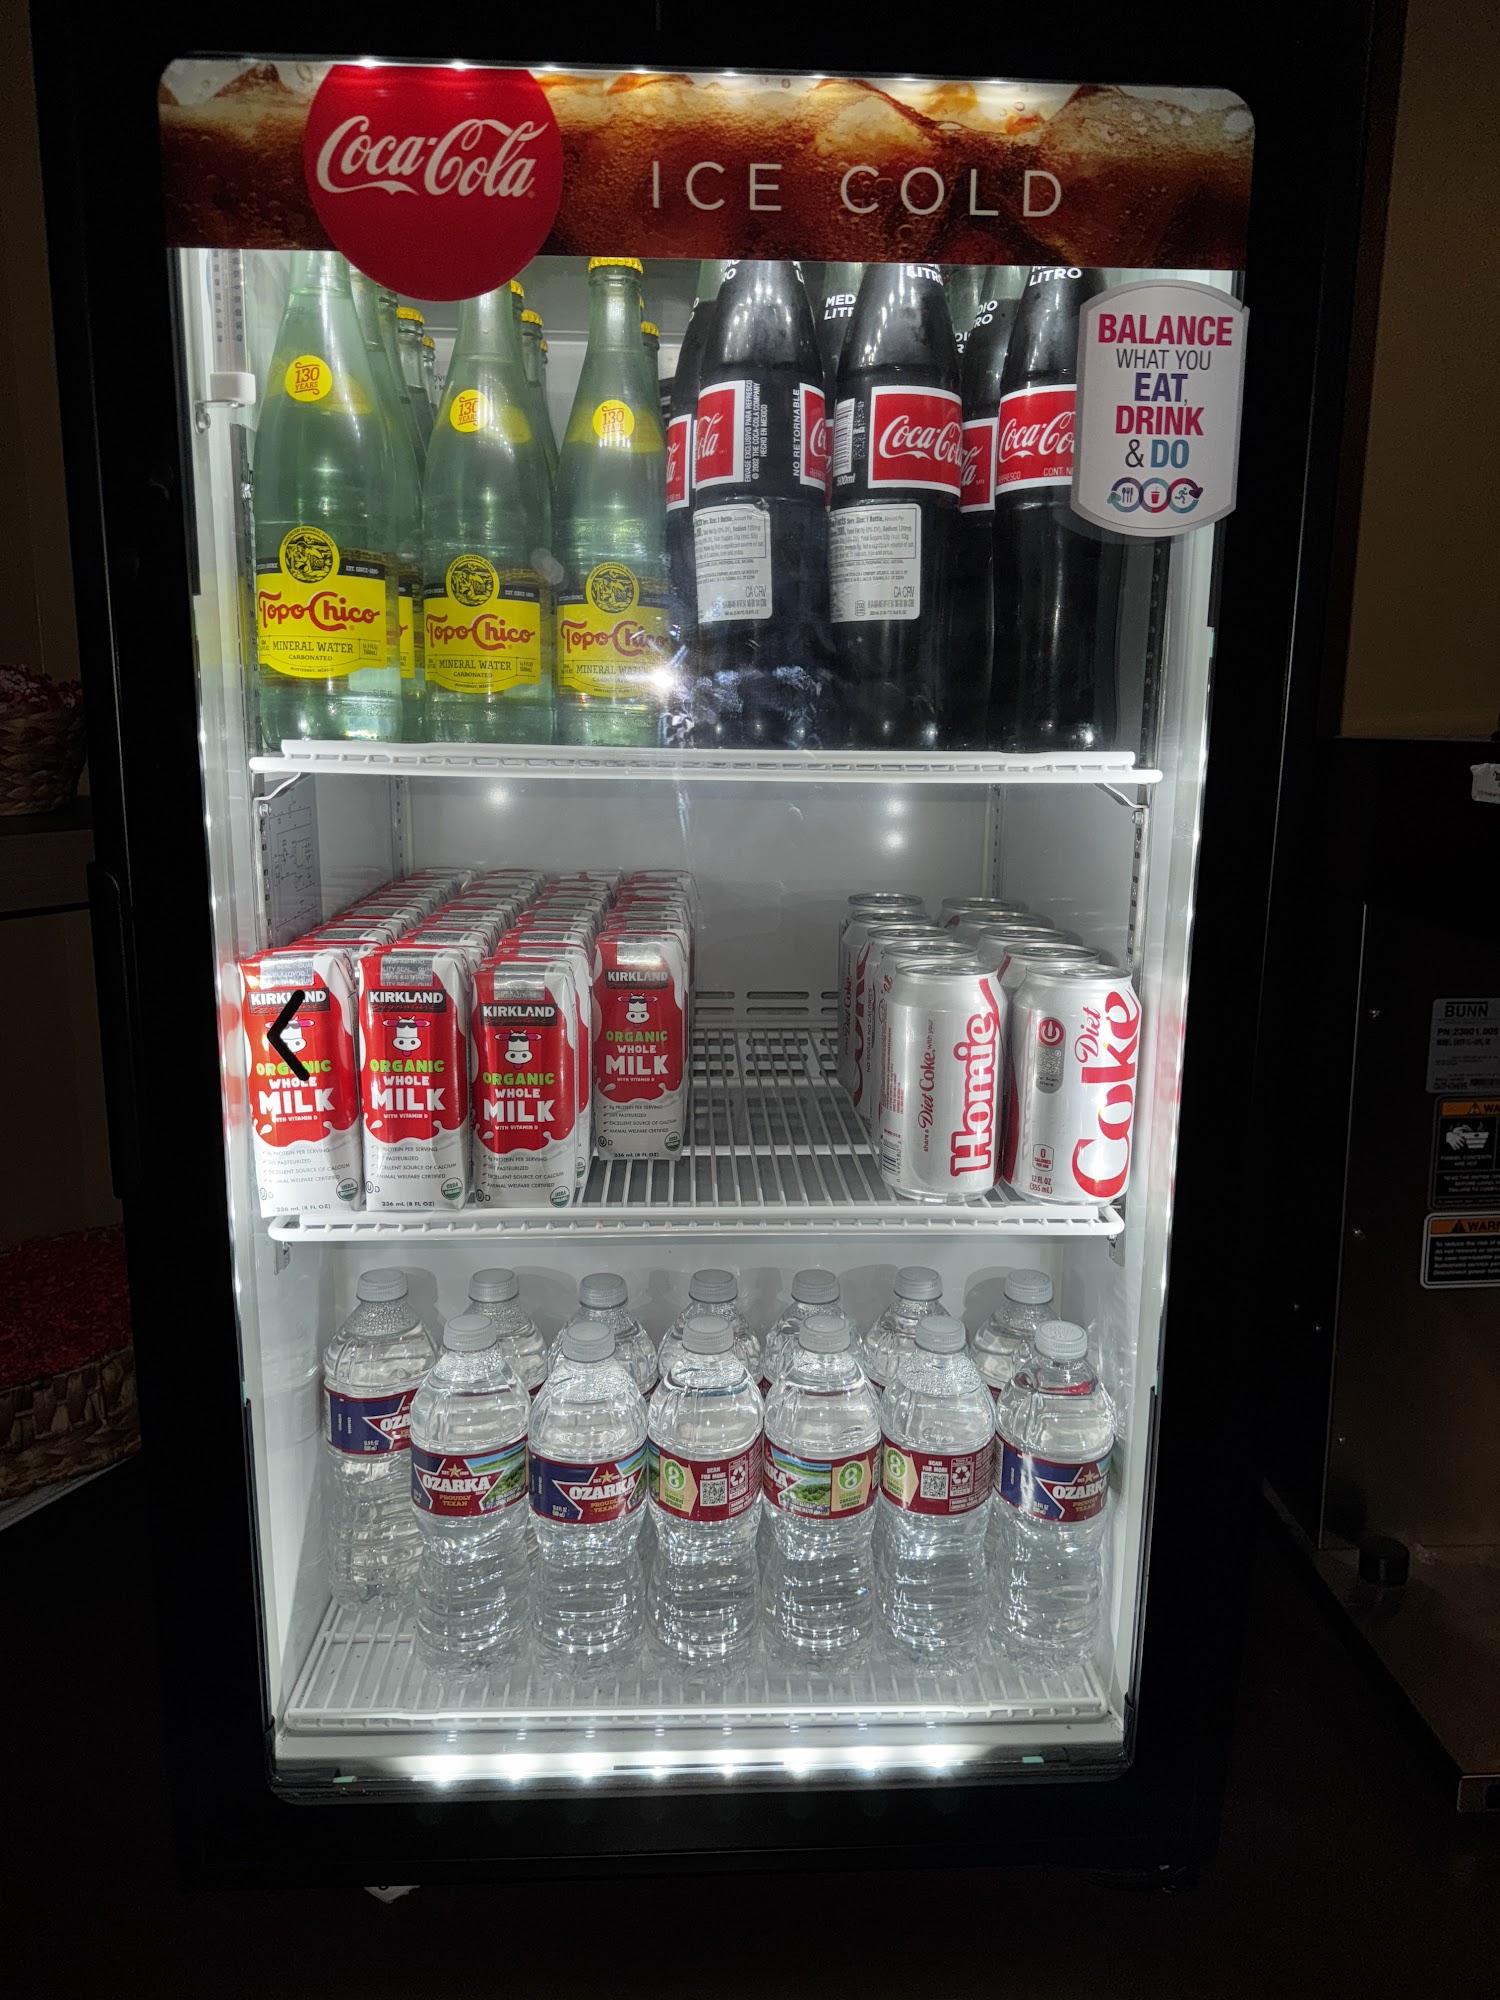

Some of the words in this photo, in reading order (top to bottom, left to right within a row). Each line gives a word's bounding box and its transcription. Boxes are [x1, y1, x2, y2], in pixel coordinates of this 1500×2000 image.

[316, 115, 549, 198] Coca-Cola
[652, 160, 783, 212] ICE
[840, 165, 1063, 218] COLD
[1028, 267, 1083, 287] LITRO
[825, 294, 857, 308] MED
[1098, 313, 1234, 346] BALANCE
[1116, 349, 1170, 369] WHAT
[1176, 350, 1212, 371] YOU
[295, 367, 320, 383] 130
[296, 382, 318, 390] YEARS
[1134, 372, 1189, 406] EAT,
[753, 382, 761, 411] COMPANY
[602, 410, 625, 425] 130
[745, 411, 753, 426] PARA
[1115, 405, 1205, 436] DRINK
[760, 427, 768, 436] EN
[745, 427, 753, 459] EXCLUSIVO
[760, 437, 768, 457] HECHO
[1124, 438, 1145, 468] &
[1150, 439, 1190, 468] DO
[793, 461, 800, 476] NO
[746, 586, 753, 598] CA
[754, 586, 767, 598] CRV
[894, 586, 902, 598] CA
[902, 586, 915, 598] CRV
[258, 590, 309, 629] Topo
[309, 591, 380, 632] Chico
[426, 614, 470, 648] Topo
[470, 613, 536, 651] Chico
[560, 620, 610, 654] Topo
[272, 640, 315, 652] MINERAL
[316, 642, 354, 653] WATER
[439, 660, 477, 669] MINERAL
[479, 660, 512, 670] WATER
[607, 971, 669, 981] KIRKLAND
[251, 990, 327, 1006] KIRKND
[369, 991, 444, 1003] KIRKLAND
[483, 1005, 556, 1017] KIRKLAND
[1445, 1004, 1488, 1018] BUNN
[606, 1030, 668, 1042] ORGANIC
[867, 1025, 872, 1036] NO
[1075, 1006, 1102, 1064] Diet
[617, 1045, 657, 1053] WHOLE
[256, 1059, 332, 1076] ORGNIC
[369, 1059, 445, 1073] ORGANIC
[606, 1054, 670, 1075] MILK
[866, 1061, 872, 1073] NO
[383, 1075, 430, 1086] WHOLE
[483, 1072, 555, 1085] ORGANIC
[950, 979, 1000, 1177] Homie
[371, 1087, 446, 1111] MILK
[495, 1088, 541, 1098] WHOLE
[1072, 987, 1142, 1198] Coke
[259, 1087, 335, 1115] MILK
[484, 1099, 555, 1122] MILK
[918, 1092, 934, 1129] Diet
[1040, 1148, 1047, 1158] 0
[543, 1171, 565, 1180] CALCIUM
[1031, 1175, 1037, 1183] 12
[1037, 1176, 1043, 1184] FL
[1044, 1177, 1052, 1185] OZ
[1030, 1183, 1041, 1192] (355
[1042, 1186, 1053, 1194] mL)
[422, 1474, 491, 1492] OZARKA
[569, 1475, 635, 1500] OZARKA
[591, 1499, 621, 1508] PROUDL
[594, 1504, 618, 1513] TEXAN
